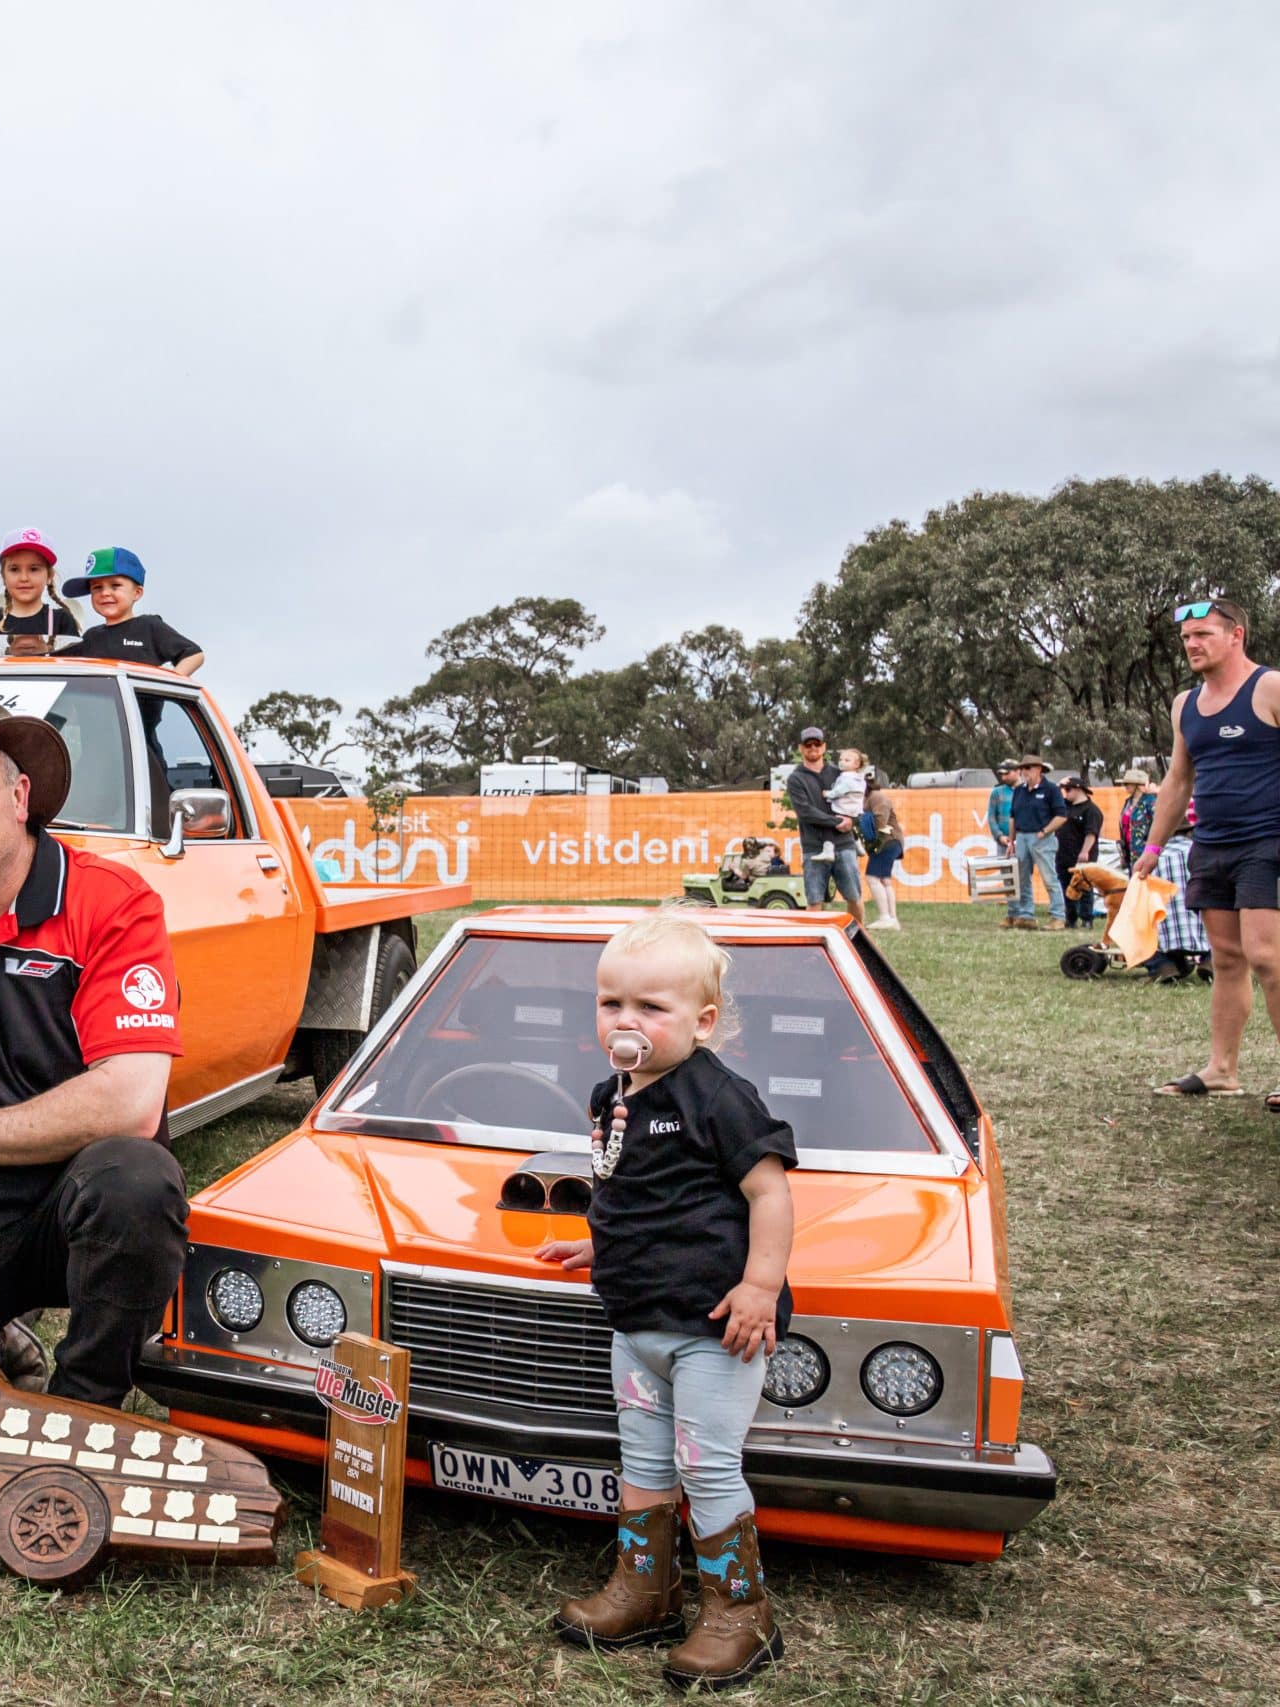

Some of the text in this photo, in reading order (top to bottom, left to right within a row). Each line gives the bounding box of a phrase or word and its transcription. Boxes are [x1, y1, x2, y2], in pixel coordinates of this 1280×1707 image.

[377, 811, 431, 834] visit
[313, 819, 470, 885] deni
[116, 1013, 175, 1031] HOLDEN
[316, 1366, 401, 1420] UteMuster
[439, 1450, 619, 1503] OWN 308
[441, 1478, 495, 1496] VICTORIA
[512, 1491, 534, 1503] THE
[540, 1496, 577, 1508] PLACE
[583, 1501, 599, 1511] TO
[330, 1478, 375, 1515] WINNER
